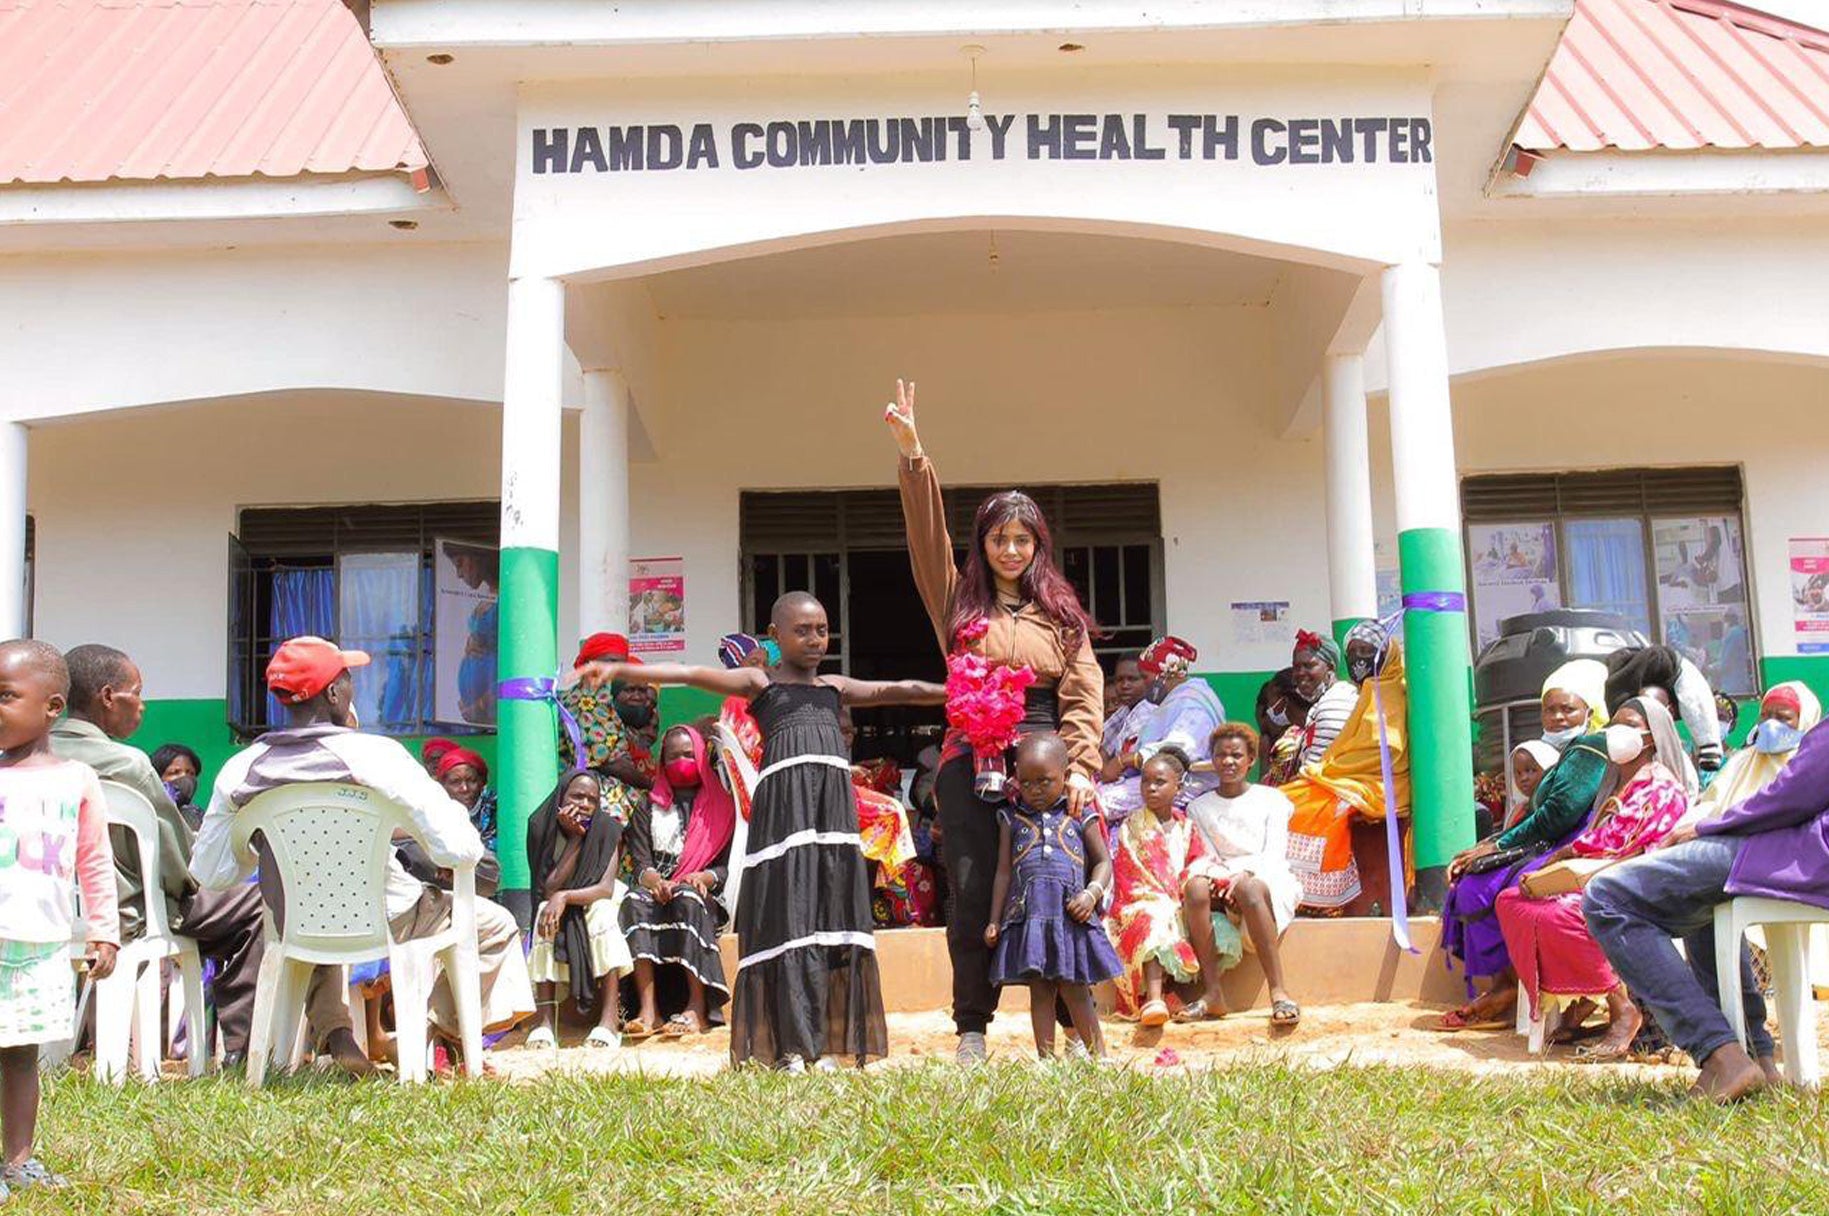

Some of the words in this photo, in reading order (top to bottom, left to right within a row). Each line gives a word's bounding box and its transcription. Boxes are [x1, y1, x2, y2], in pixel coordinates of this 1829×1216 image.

[532, 123, 719, 174] HAMDA
[730, 114, 1015, 170] COMMUNITY
[1026, 113, 1239, 160] HEALTH
[1250, 117, 1432, 167] CENTER
